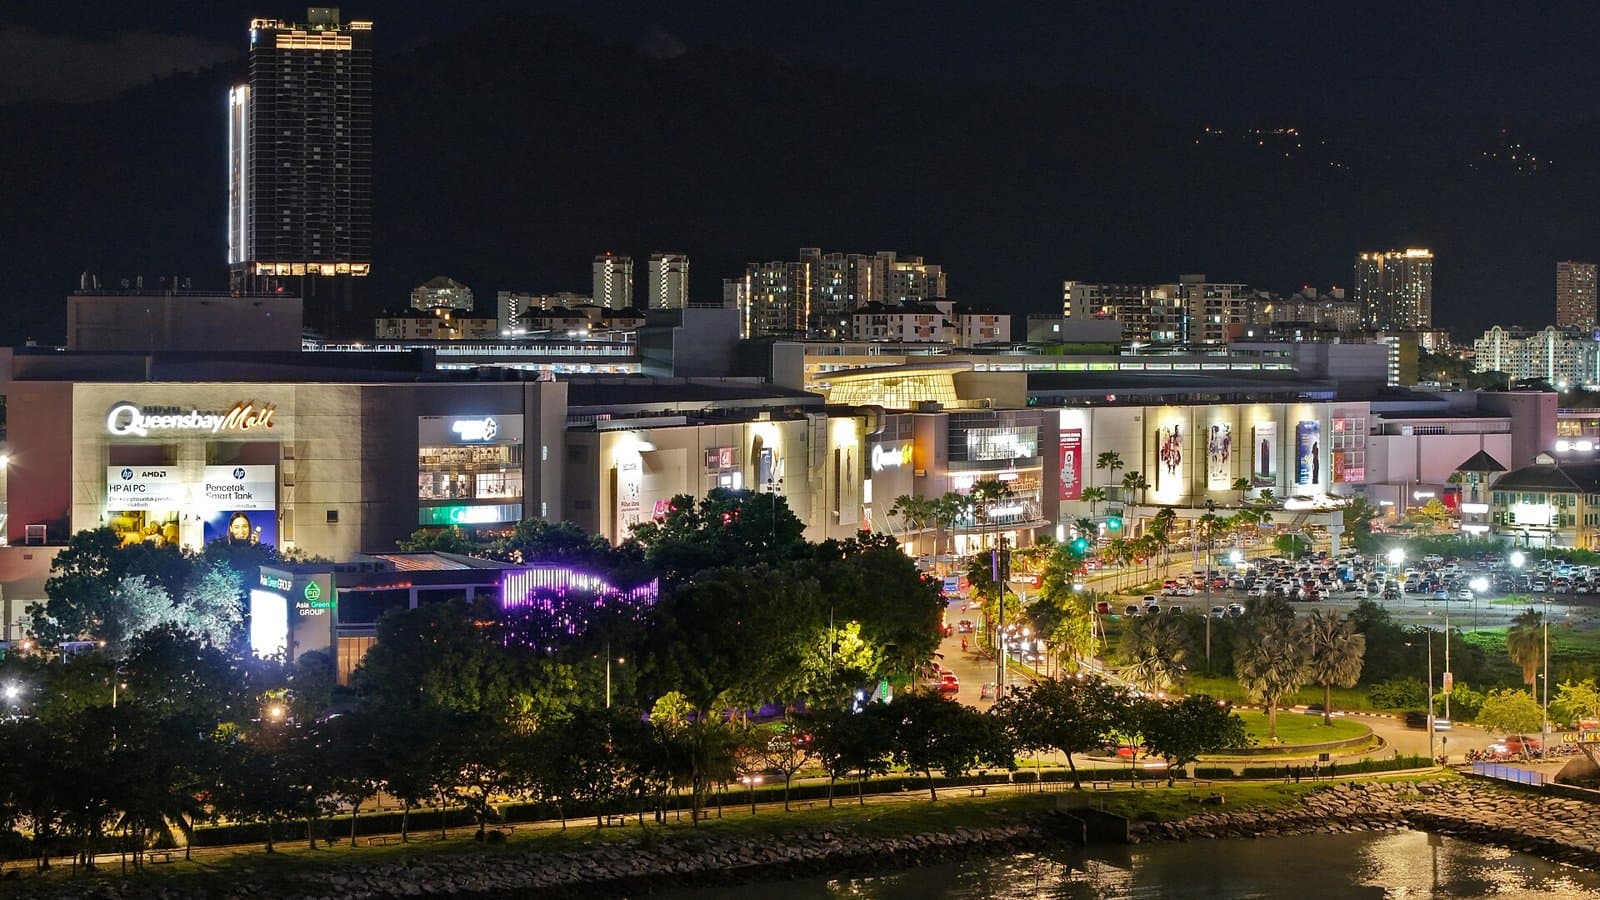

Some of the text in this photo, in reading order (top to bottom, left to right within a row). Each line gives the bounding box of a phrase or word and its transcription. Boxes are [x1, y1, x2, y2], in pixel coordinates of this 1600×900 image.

[108, 404, 275, 436] Queensbay Mall
[109, 484, 146, 493] HP AI PC
[205, 483, 245, 492] Pencetak
[206, 491, 253, 500] Smart Tank
[295, 601, 331, 609] Asia Green
[299, 608, 325, 616] GROUP
